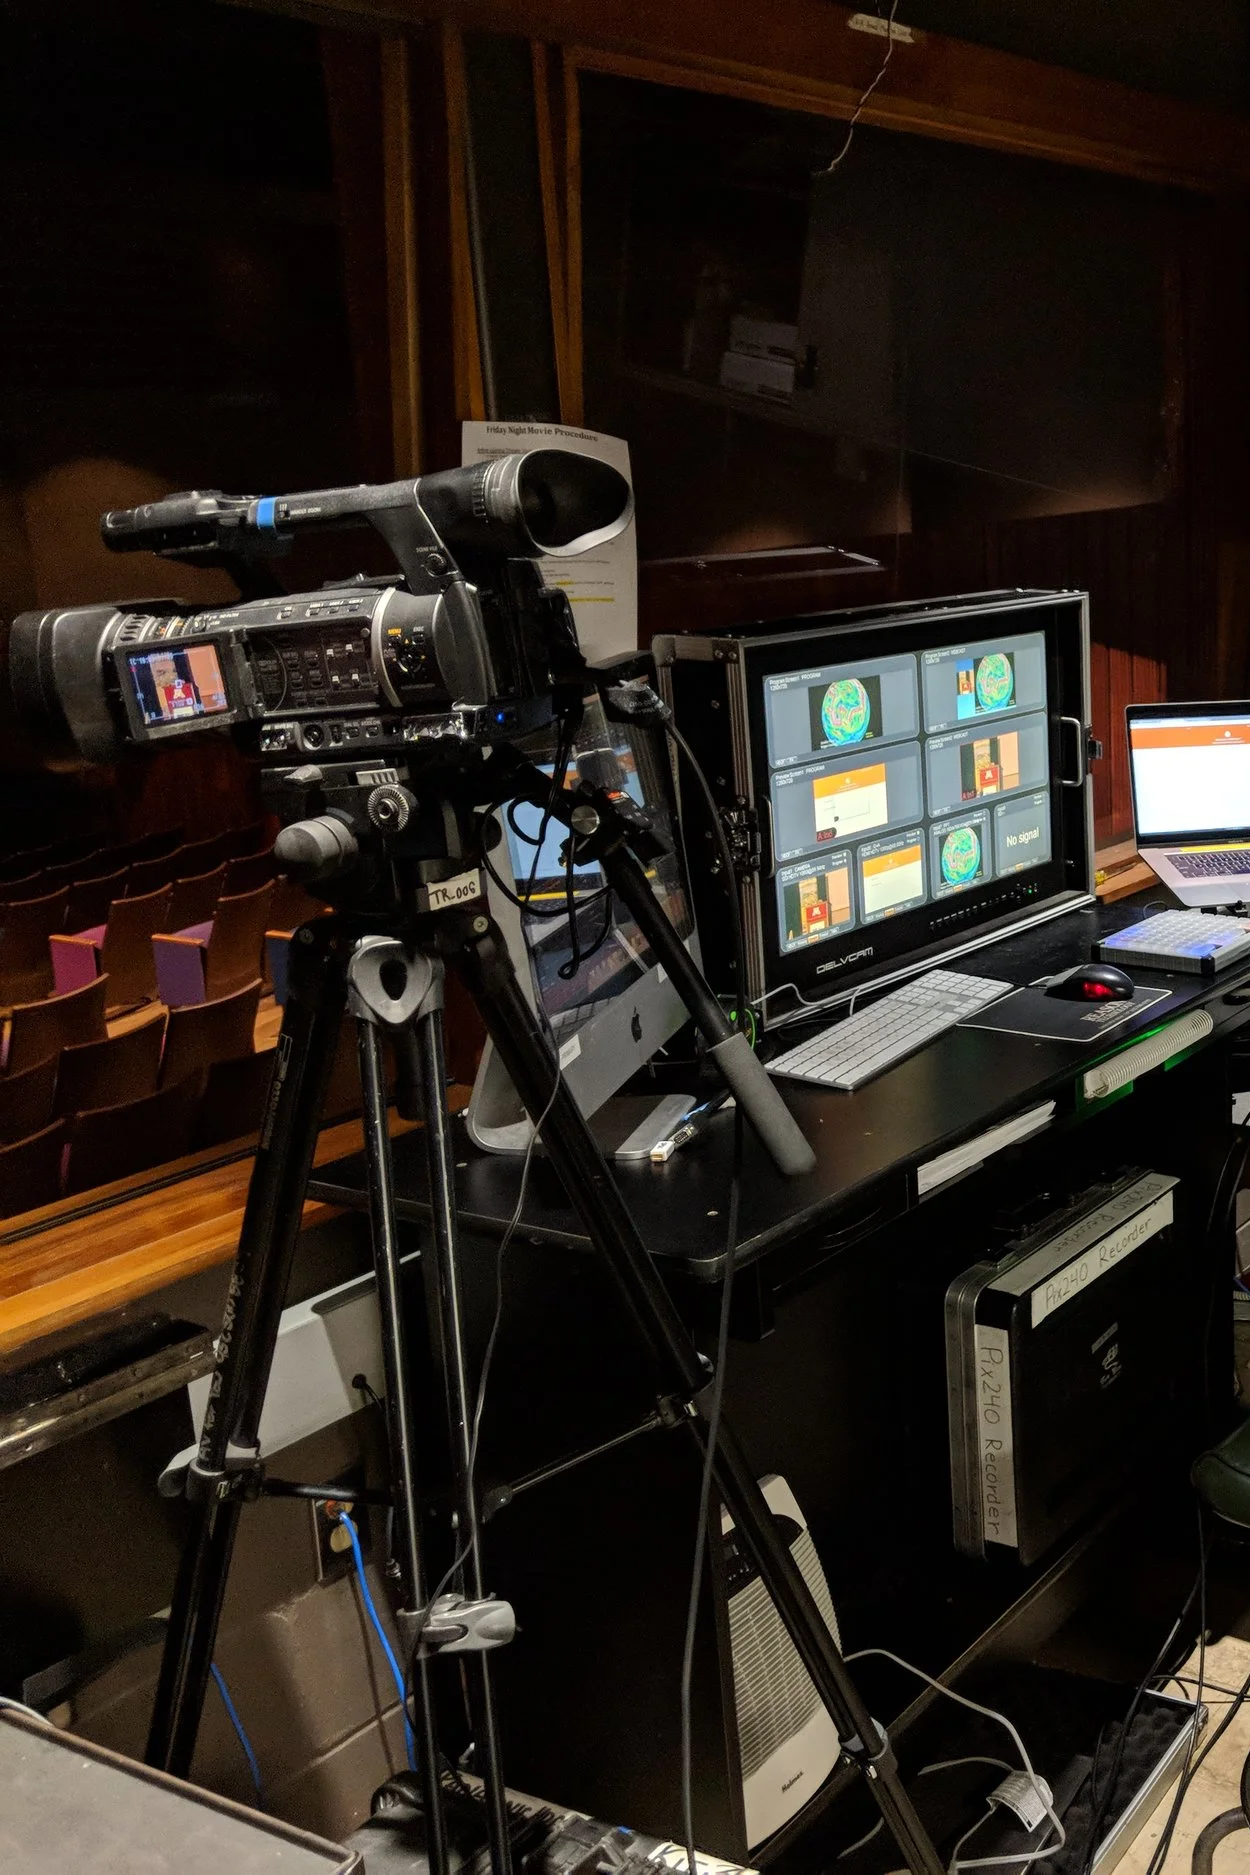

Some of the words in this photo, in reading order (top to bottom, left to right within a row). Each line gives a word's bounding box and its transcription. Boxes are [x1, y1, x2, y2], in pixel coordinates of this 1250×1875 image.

[486, 426, 506, 435] Friday
[508, 426, 527, 436] Night
[528, 426, 552, 435] Movie
[554, 428, 598, 441] Procedure
[1006, 835, 1017, 847] No
[1019, 827, 1040, 844] signal
[816, 947, 874, 974] DELVCAM
[1046, 1263, 1088, 1310] Pix240
[1100, 1218, 1152, 1263] Recorder
[980, 1347, 1003, 1425] Pix240
[985, 1438, 1002, 1536] Recorder
